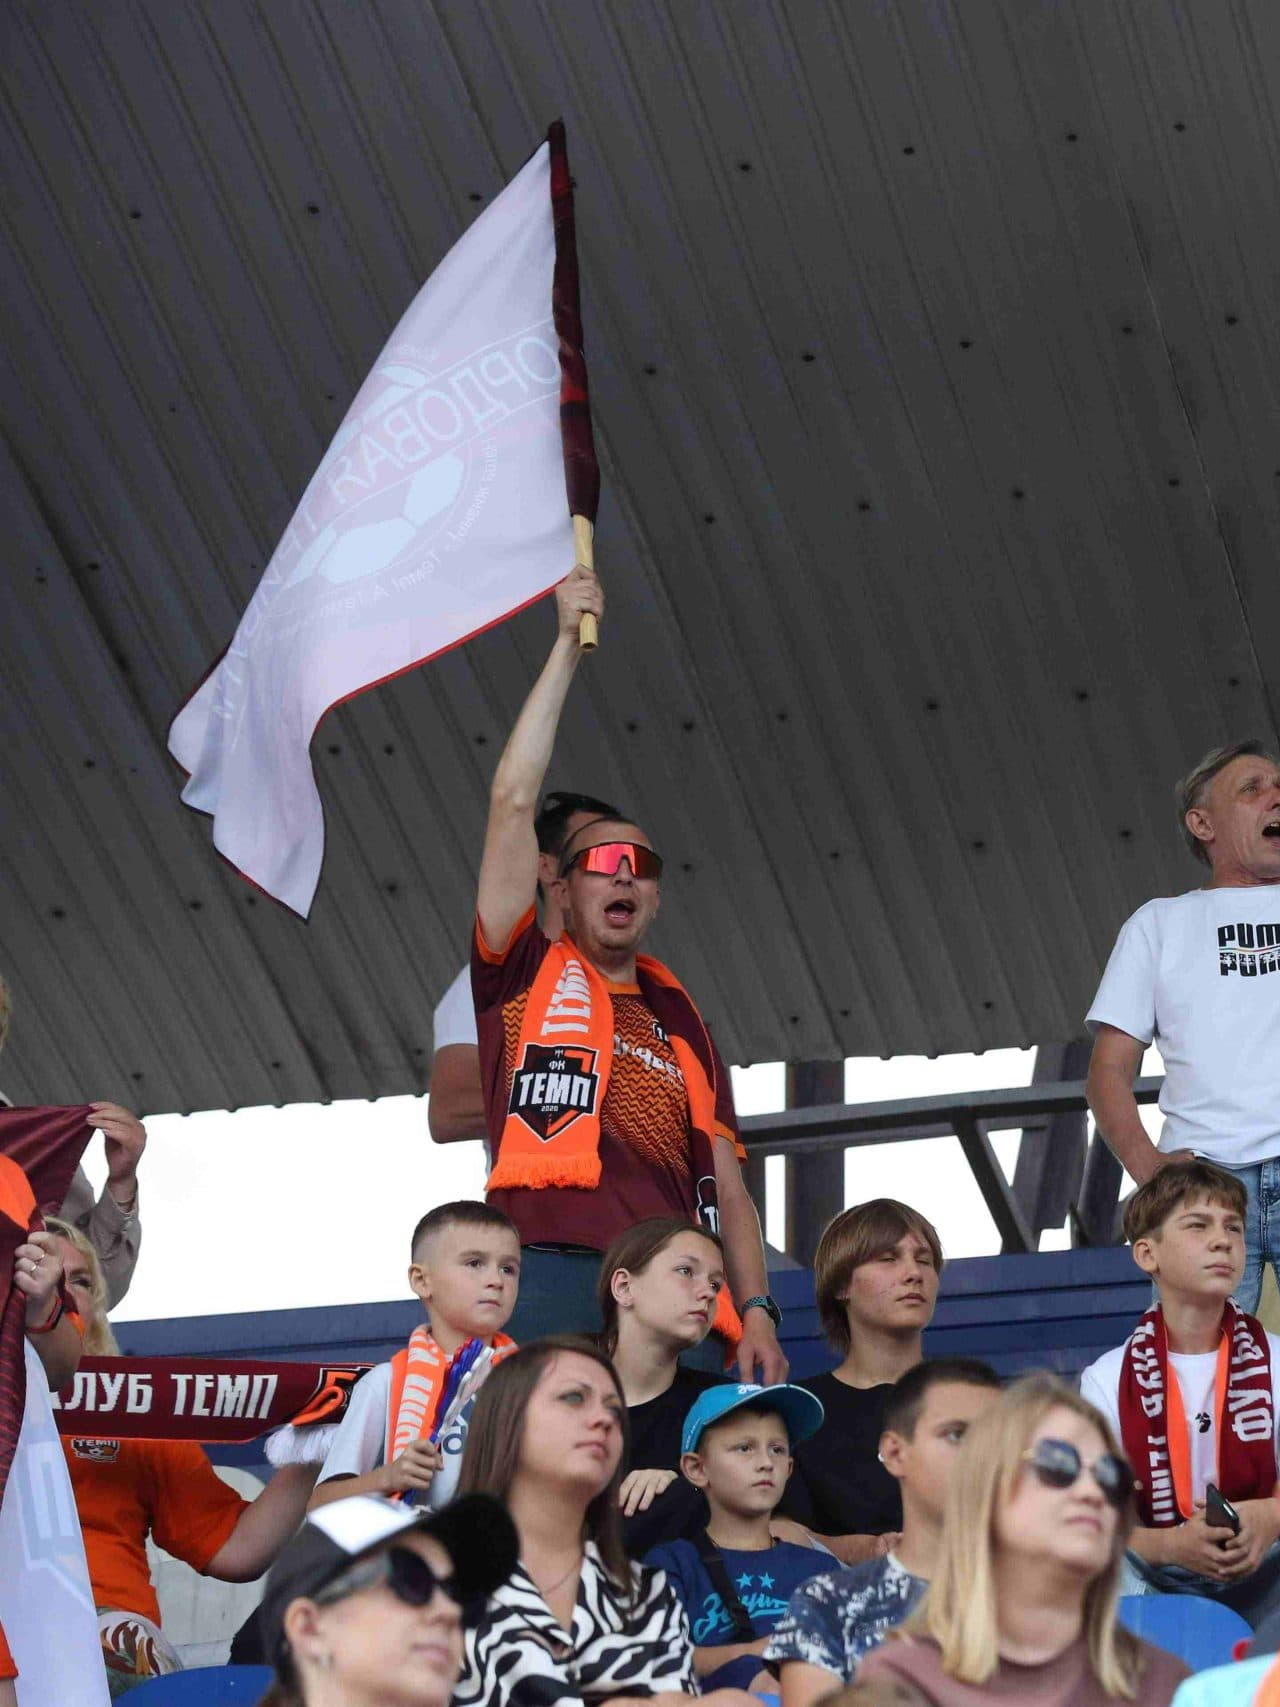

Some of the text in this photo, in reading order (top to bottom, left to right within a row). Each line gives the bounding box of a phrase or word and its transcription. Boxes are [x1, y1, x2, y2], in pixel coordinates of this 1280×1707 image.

[549, 1060, 566, 1071] ФК
[518, 1072, 592, 1107] ТЕМП
[50, 1372, 278, 1419] ЛУБ ТЕМП
